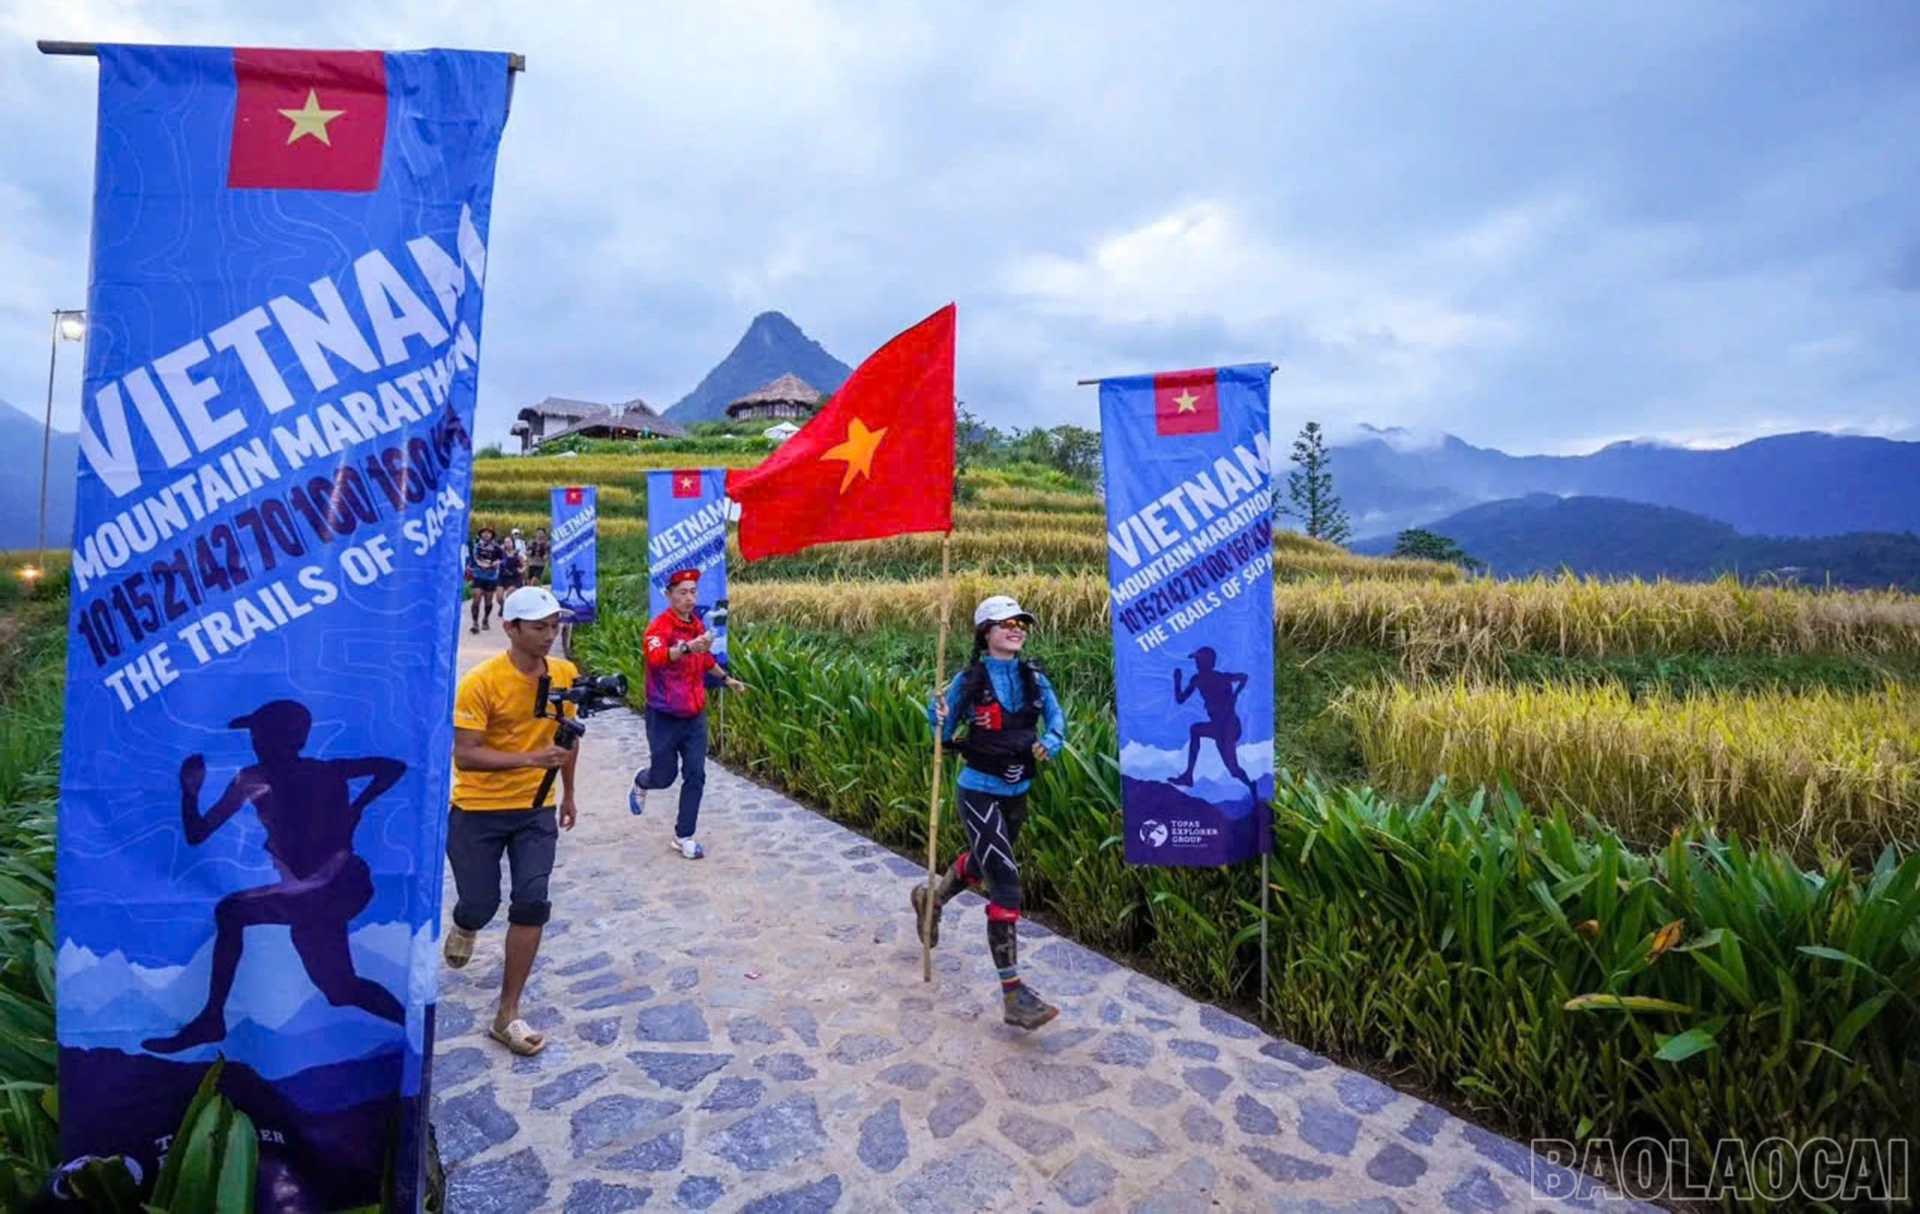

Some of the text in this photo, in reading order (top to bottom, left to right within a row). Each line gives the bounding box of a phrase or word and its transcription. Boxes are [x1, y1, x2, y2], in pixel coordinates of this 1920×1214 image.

[80, 203, 486, 498] VIETNAM
[73, 320, 477, 592] MOUNTAIN MARATHN
[551, 505, 596, 542] VIETNAM
[648, 497, 731, 558] VIETNAM
[1108, 432, 1270, 568] VIETNAM
[1111, 541, 1196, 606] MOUNTAIN
[103, 642, 179, 712] THE
[177, 565, 338, 667] TRAILS
[339, 533, 395, 587] OF
[1136, 624, 1169, 652] THE
[1166, 591, 1221, 633] TRAILS
[1220, 577, 1242, 599] OF
[1171, 820, 1200, 828] TOPAS
[1171, 828, 1218, 836] EXPLORER
